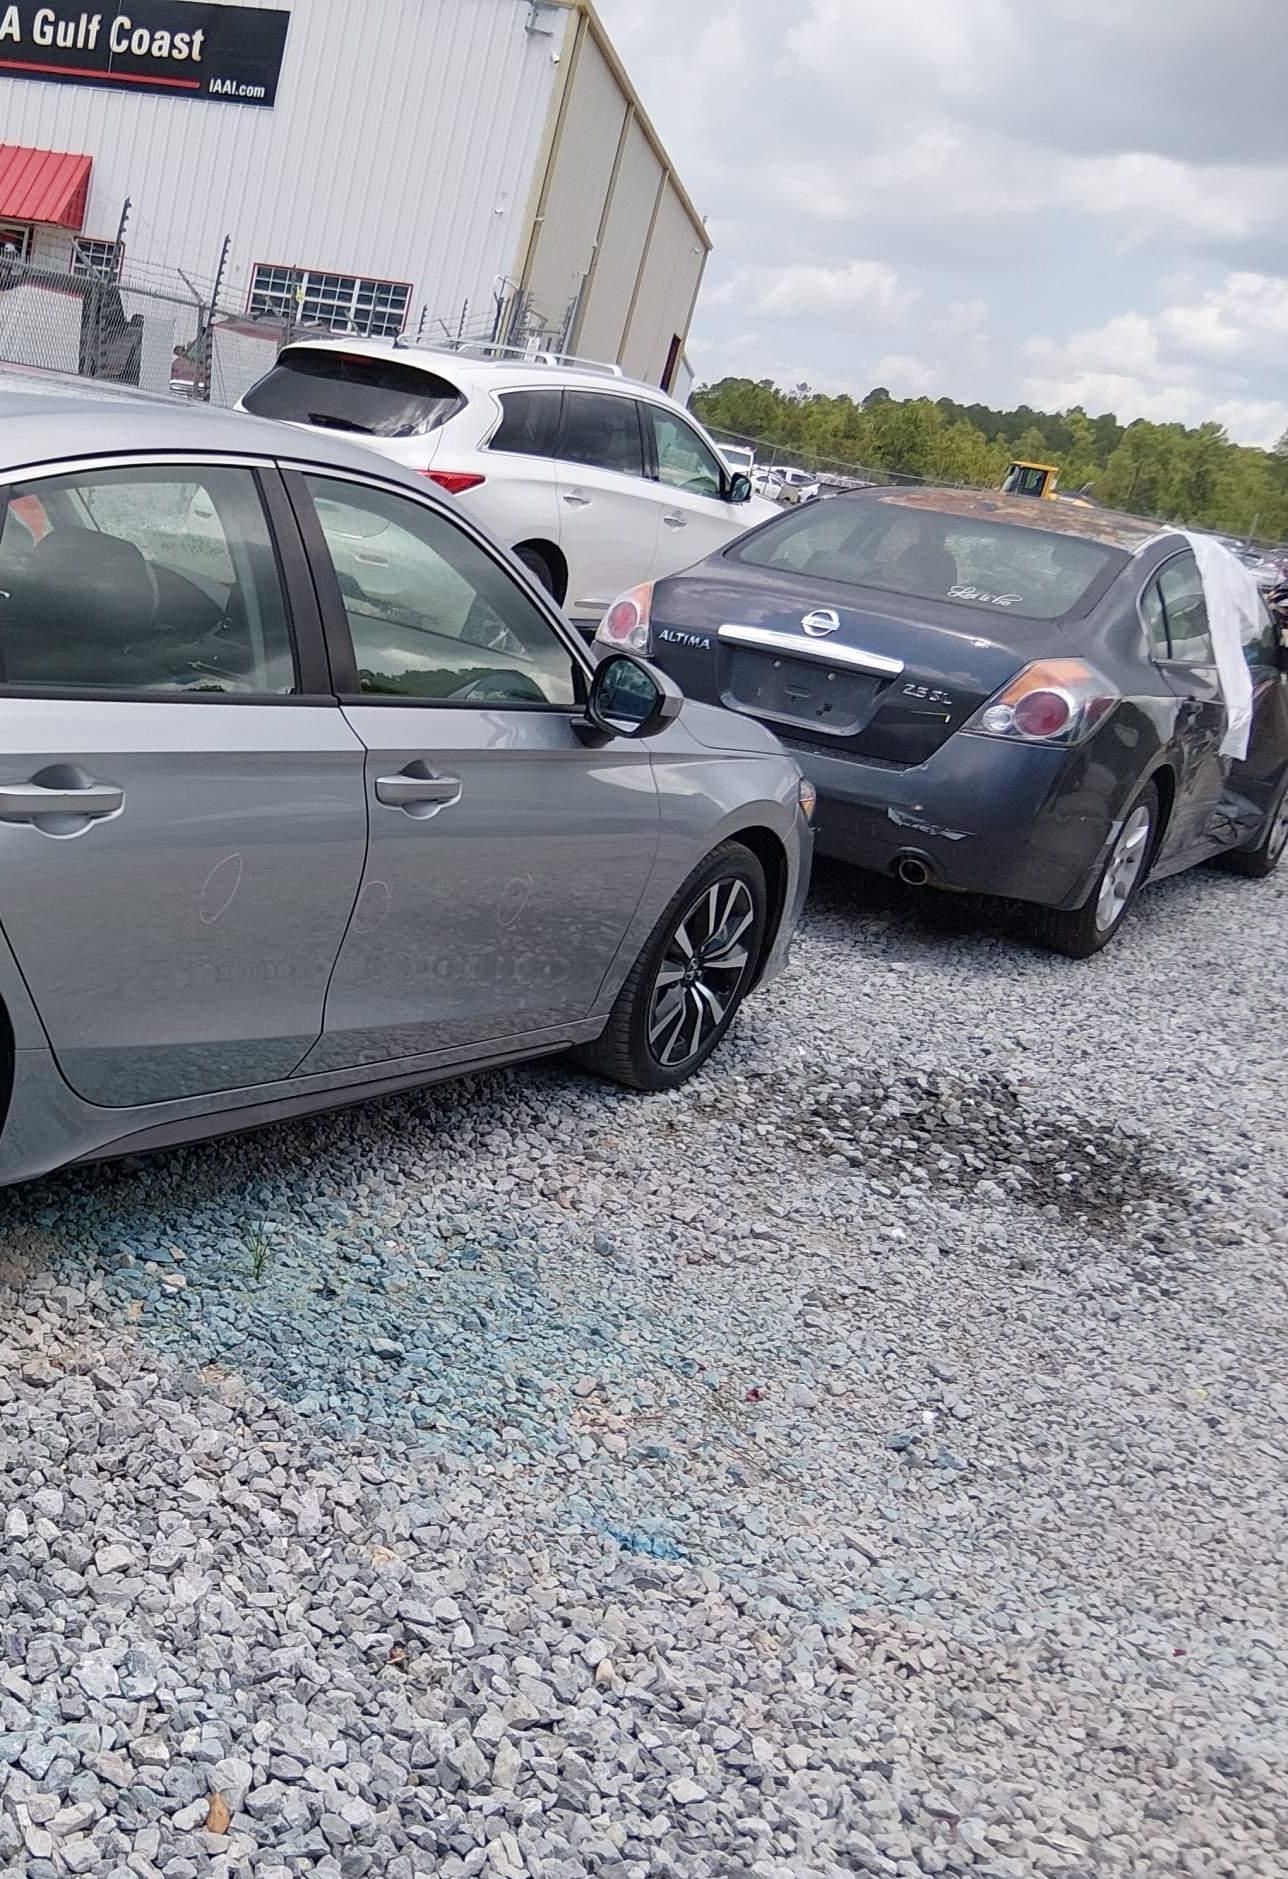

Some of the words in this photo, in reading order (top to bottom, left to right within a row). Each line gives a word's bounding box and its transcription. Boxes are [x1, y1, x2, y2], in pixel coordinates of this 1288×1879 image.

[32, 8, 102, 50] Gulf
[109, 15, 205, 62] Coast
[209, 77, 265, 98] IAAI.com
[658, 629, 711, 650] ALTIMA
